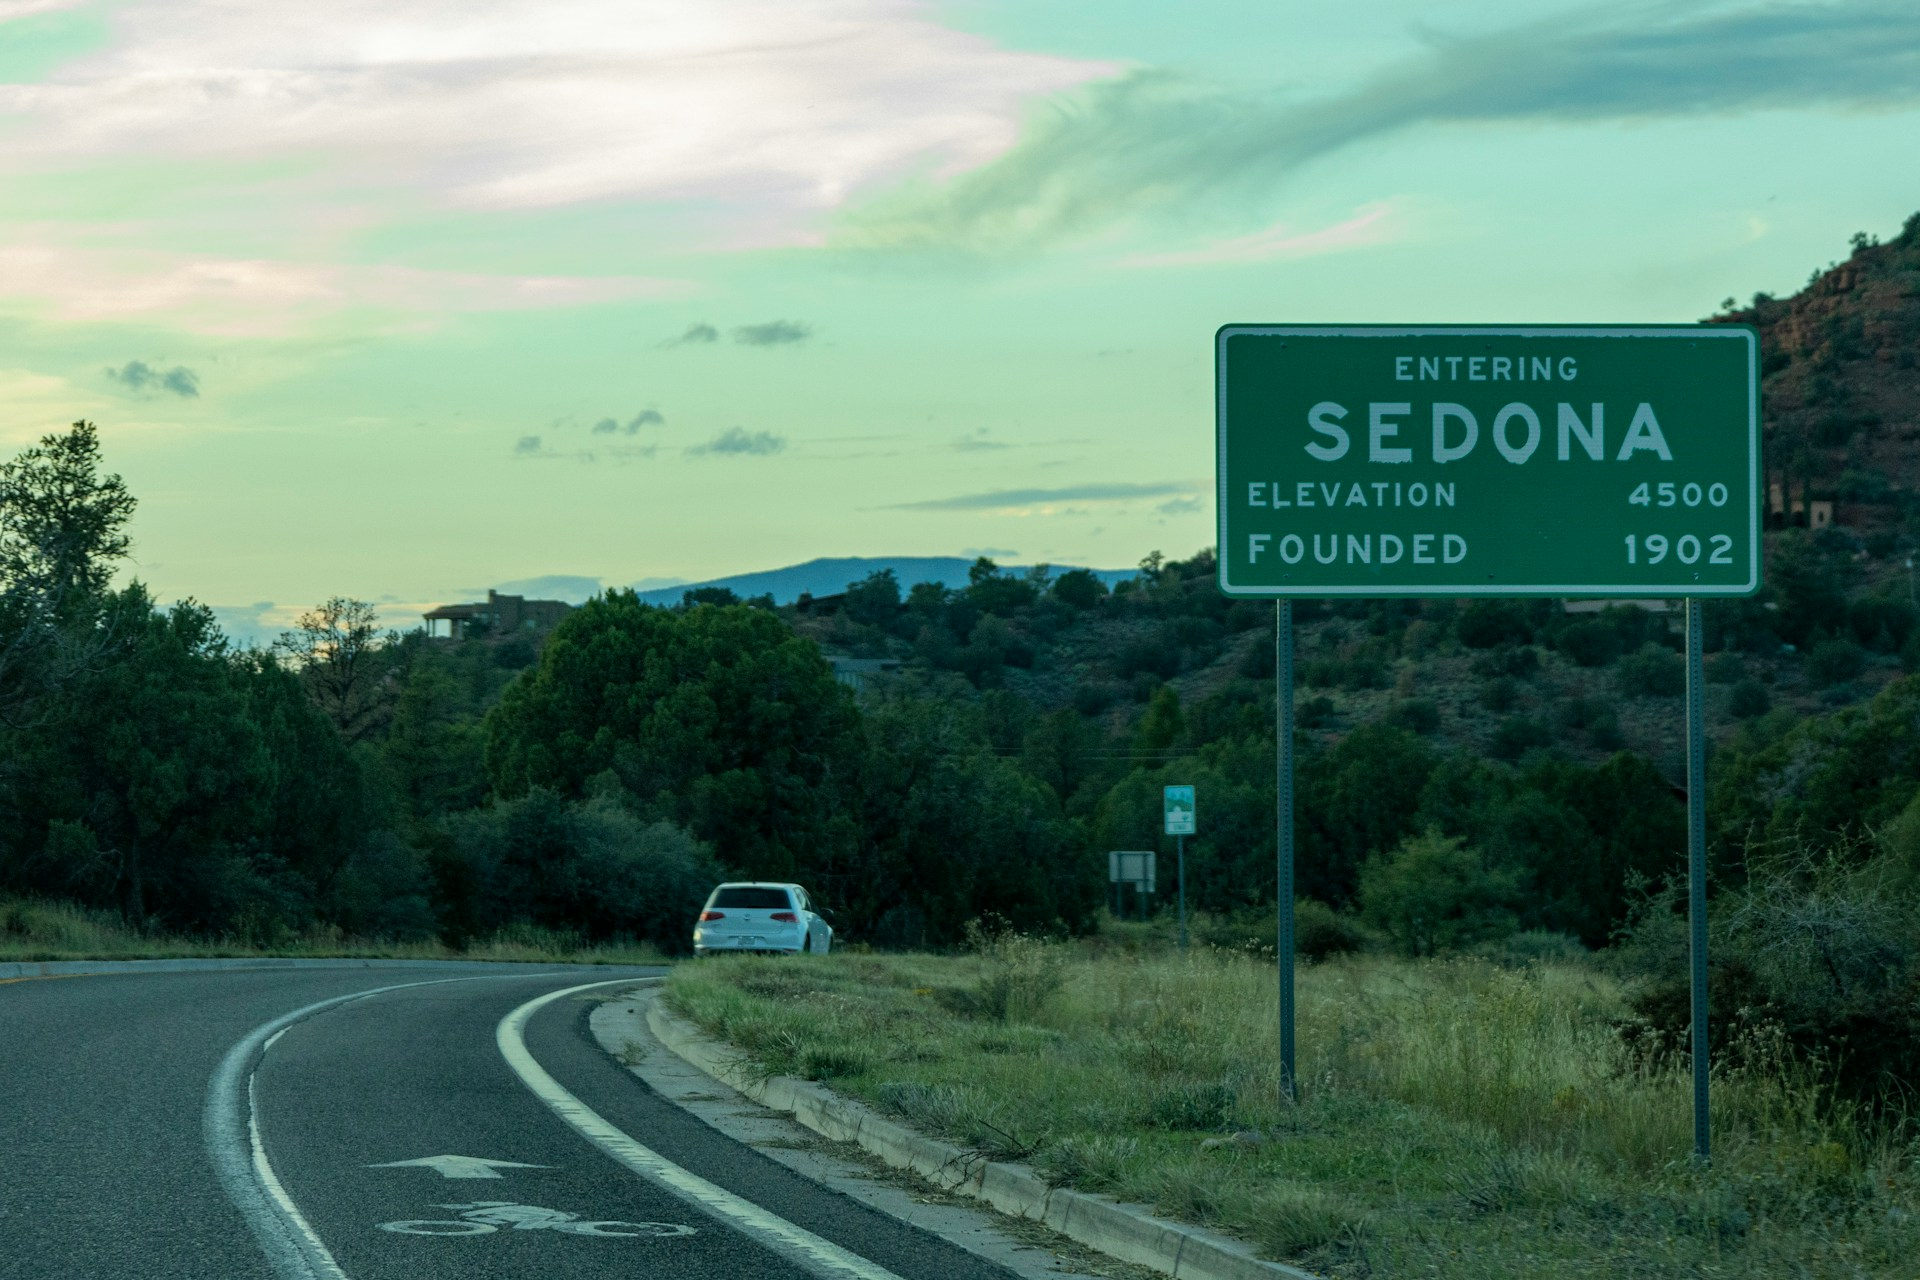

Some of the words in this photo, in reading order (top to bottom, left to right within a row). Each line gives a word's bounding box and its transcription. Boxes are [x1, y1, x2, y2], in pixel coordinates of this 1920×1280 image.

[1396, 357, 1577, 380] ENTERING
[1305, 402, 1672, 464] SEDONA
[1249, 483, 1454, 508] ELEVATION
[1629, 483, 1727, 506] 4500
[1250, 534, 1466, 564] FOUNDED
[1626, 535, 1732, 564] 1902
